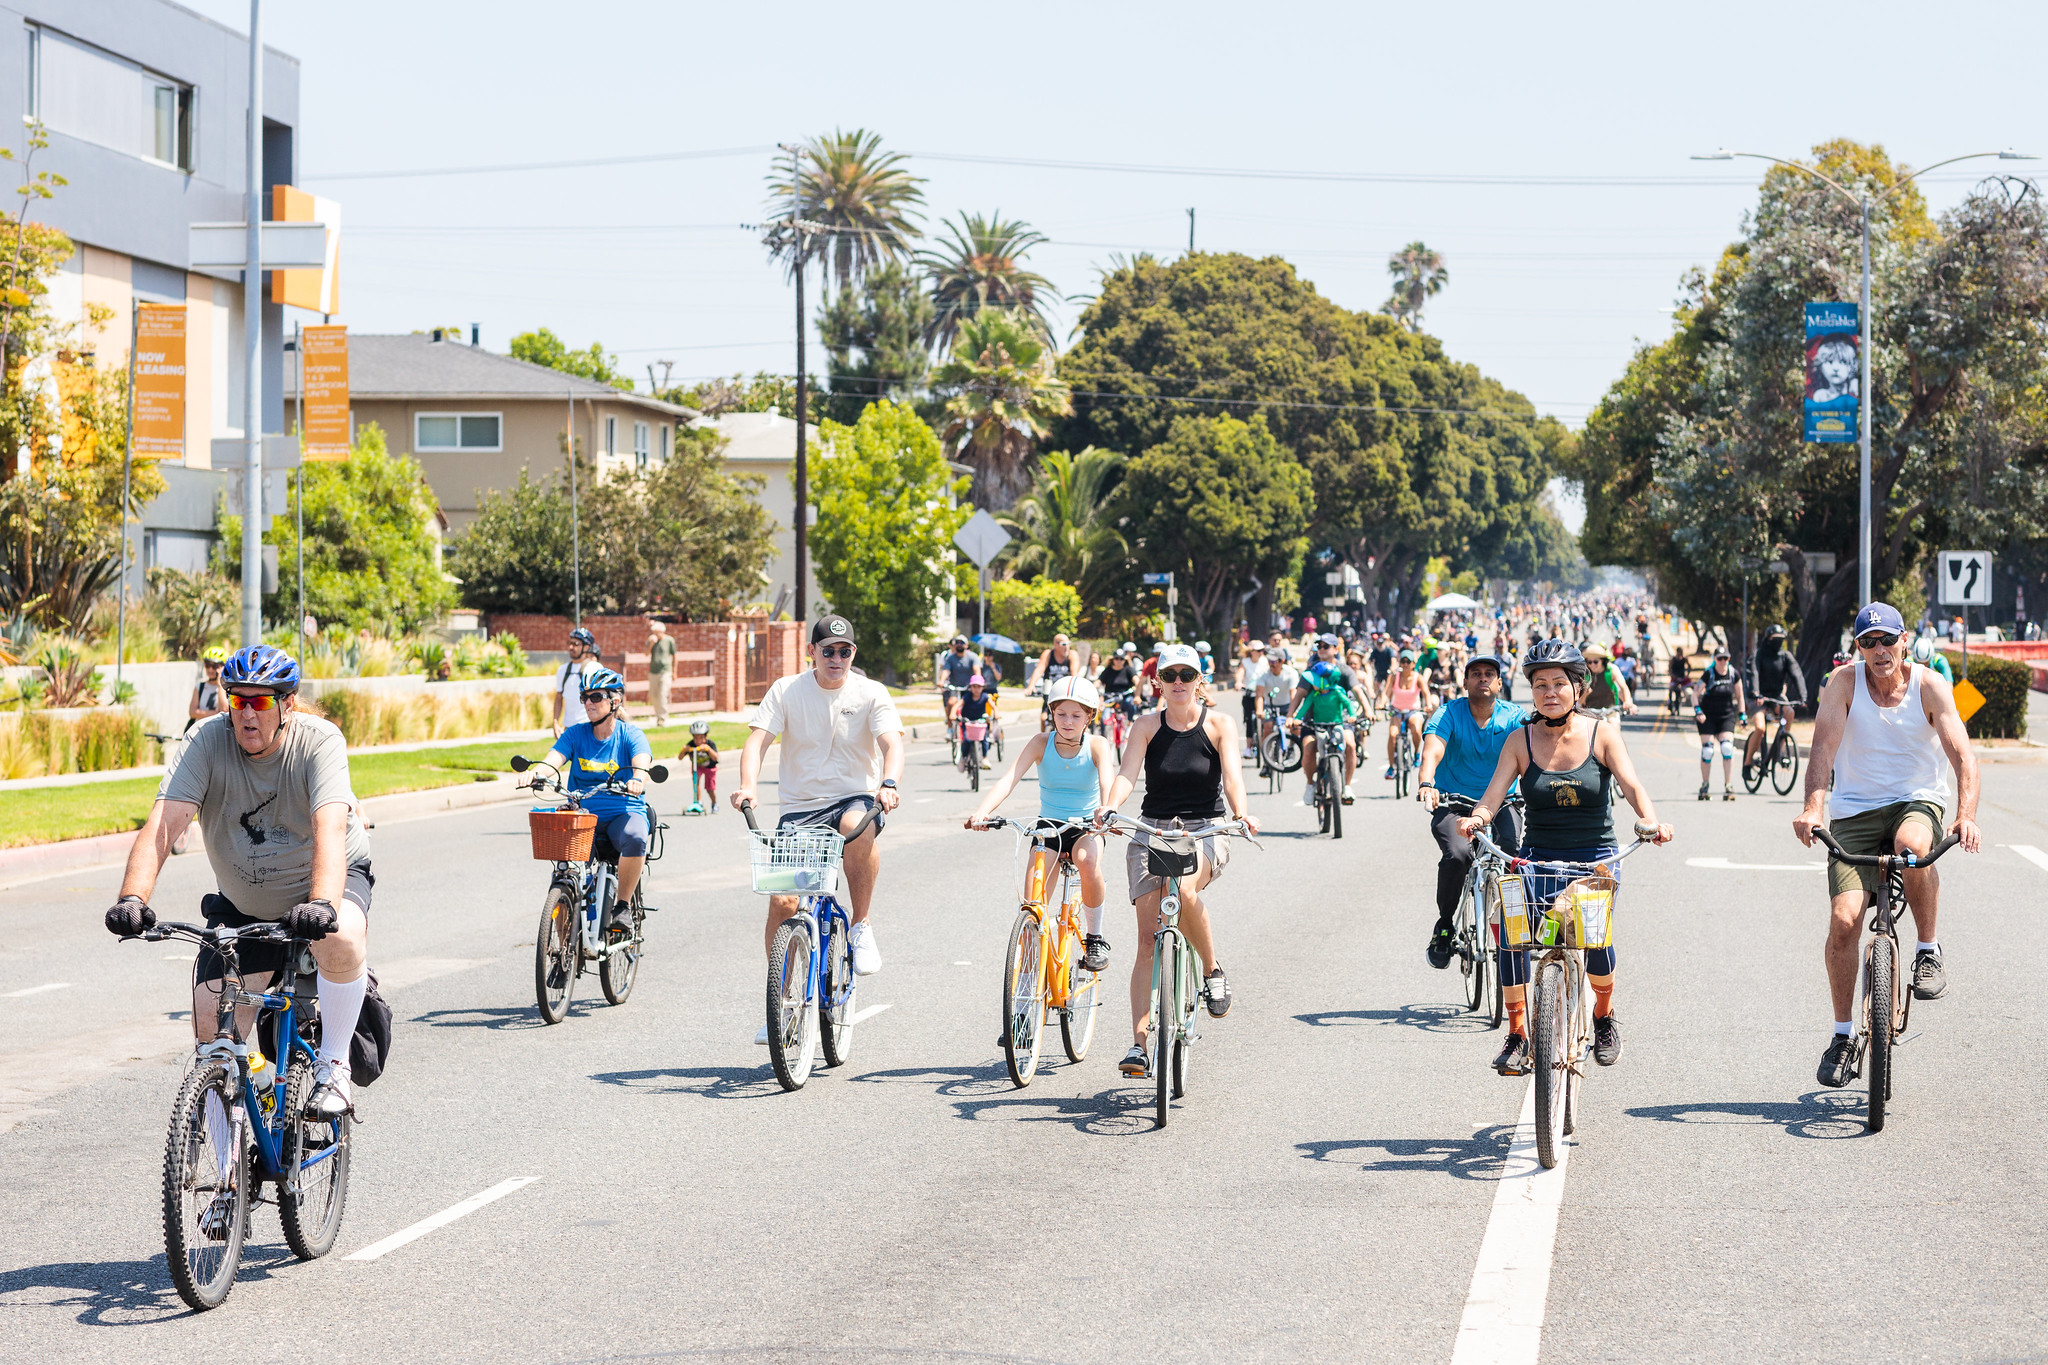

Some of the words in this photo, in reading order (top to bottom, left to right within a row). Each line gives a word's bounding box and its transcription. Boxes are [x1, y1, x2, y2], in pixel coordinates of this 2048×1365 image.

[137, 352, 165, 363] NOW
[137, 364, 185, 376] LEASING
[306, 381, 346, 389] BEDROOM
[138, 391, 180, 400] EXPERIENCE
[306, 390, 330, 398] UNITS
[137, 406, 169, 414] MODERN
[137, 414, 172, 422] LIFESTYLE
[1869, 610, 1882, 624] LA
[1549, 780, 1570, 789] Temple
